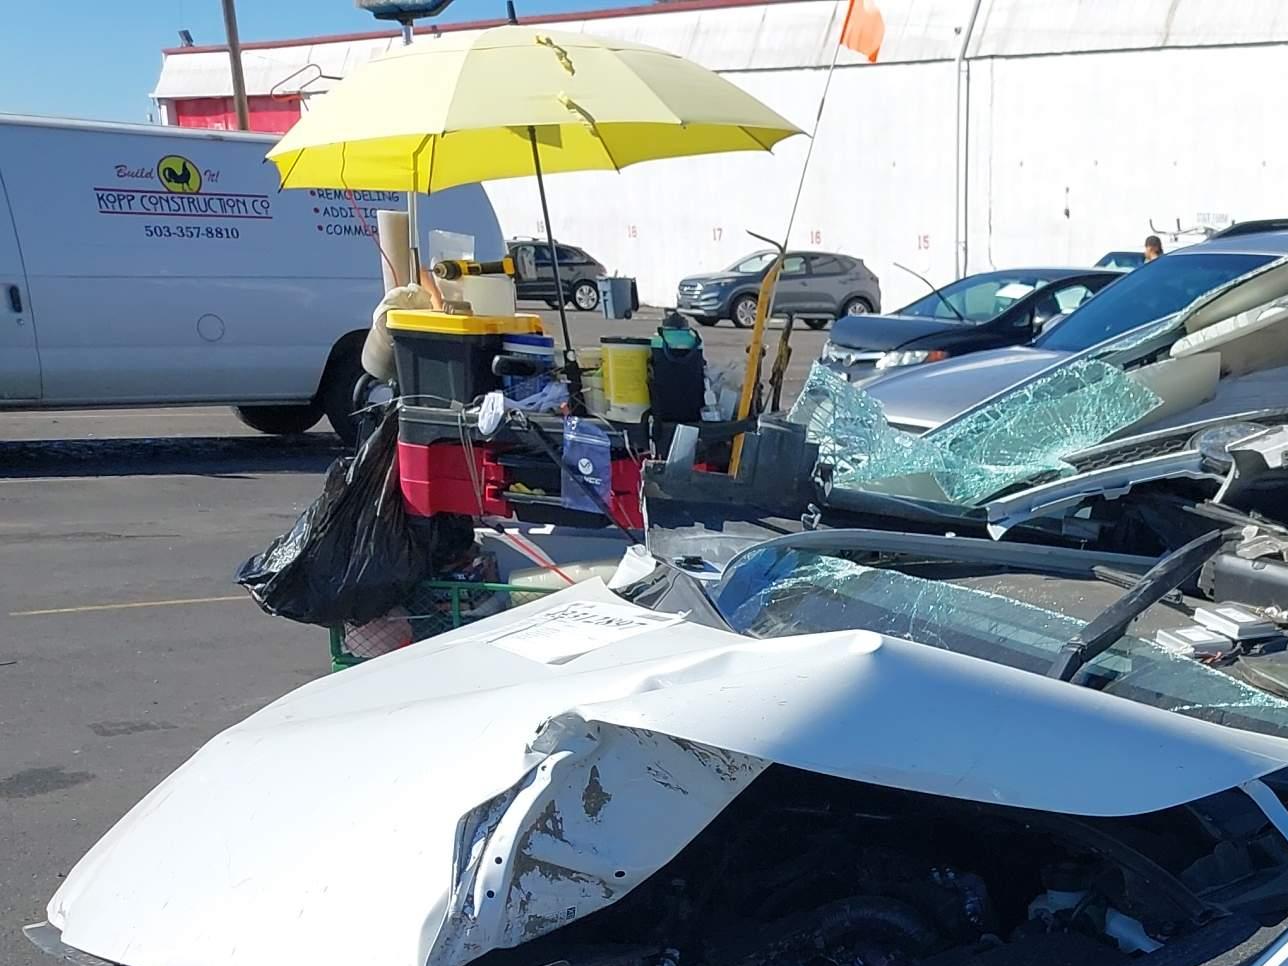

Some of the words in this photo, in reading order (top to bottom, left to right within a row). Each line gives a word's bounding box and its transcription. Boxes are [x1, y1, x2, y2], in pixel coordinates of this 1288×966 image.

[114, 164, 154, 180] Build
[203, 169, 220, 183] It!
[316, 189, 400, 202] REMODELING
[96, 192, 136, 211] KOPP
[140, 194, 249, 215] CONSTRUCTION
[251, 199, 270, 216] CO
[144, 224, 240, 240] 503-357-8810
[712, 227, 723, 242] 17
[810, 230, 822, 245] 16
[917, 234, 931, 250] 15
